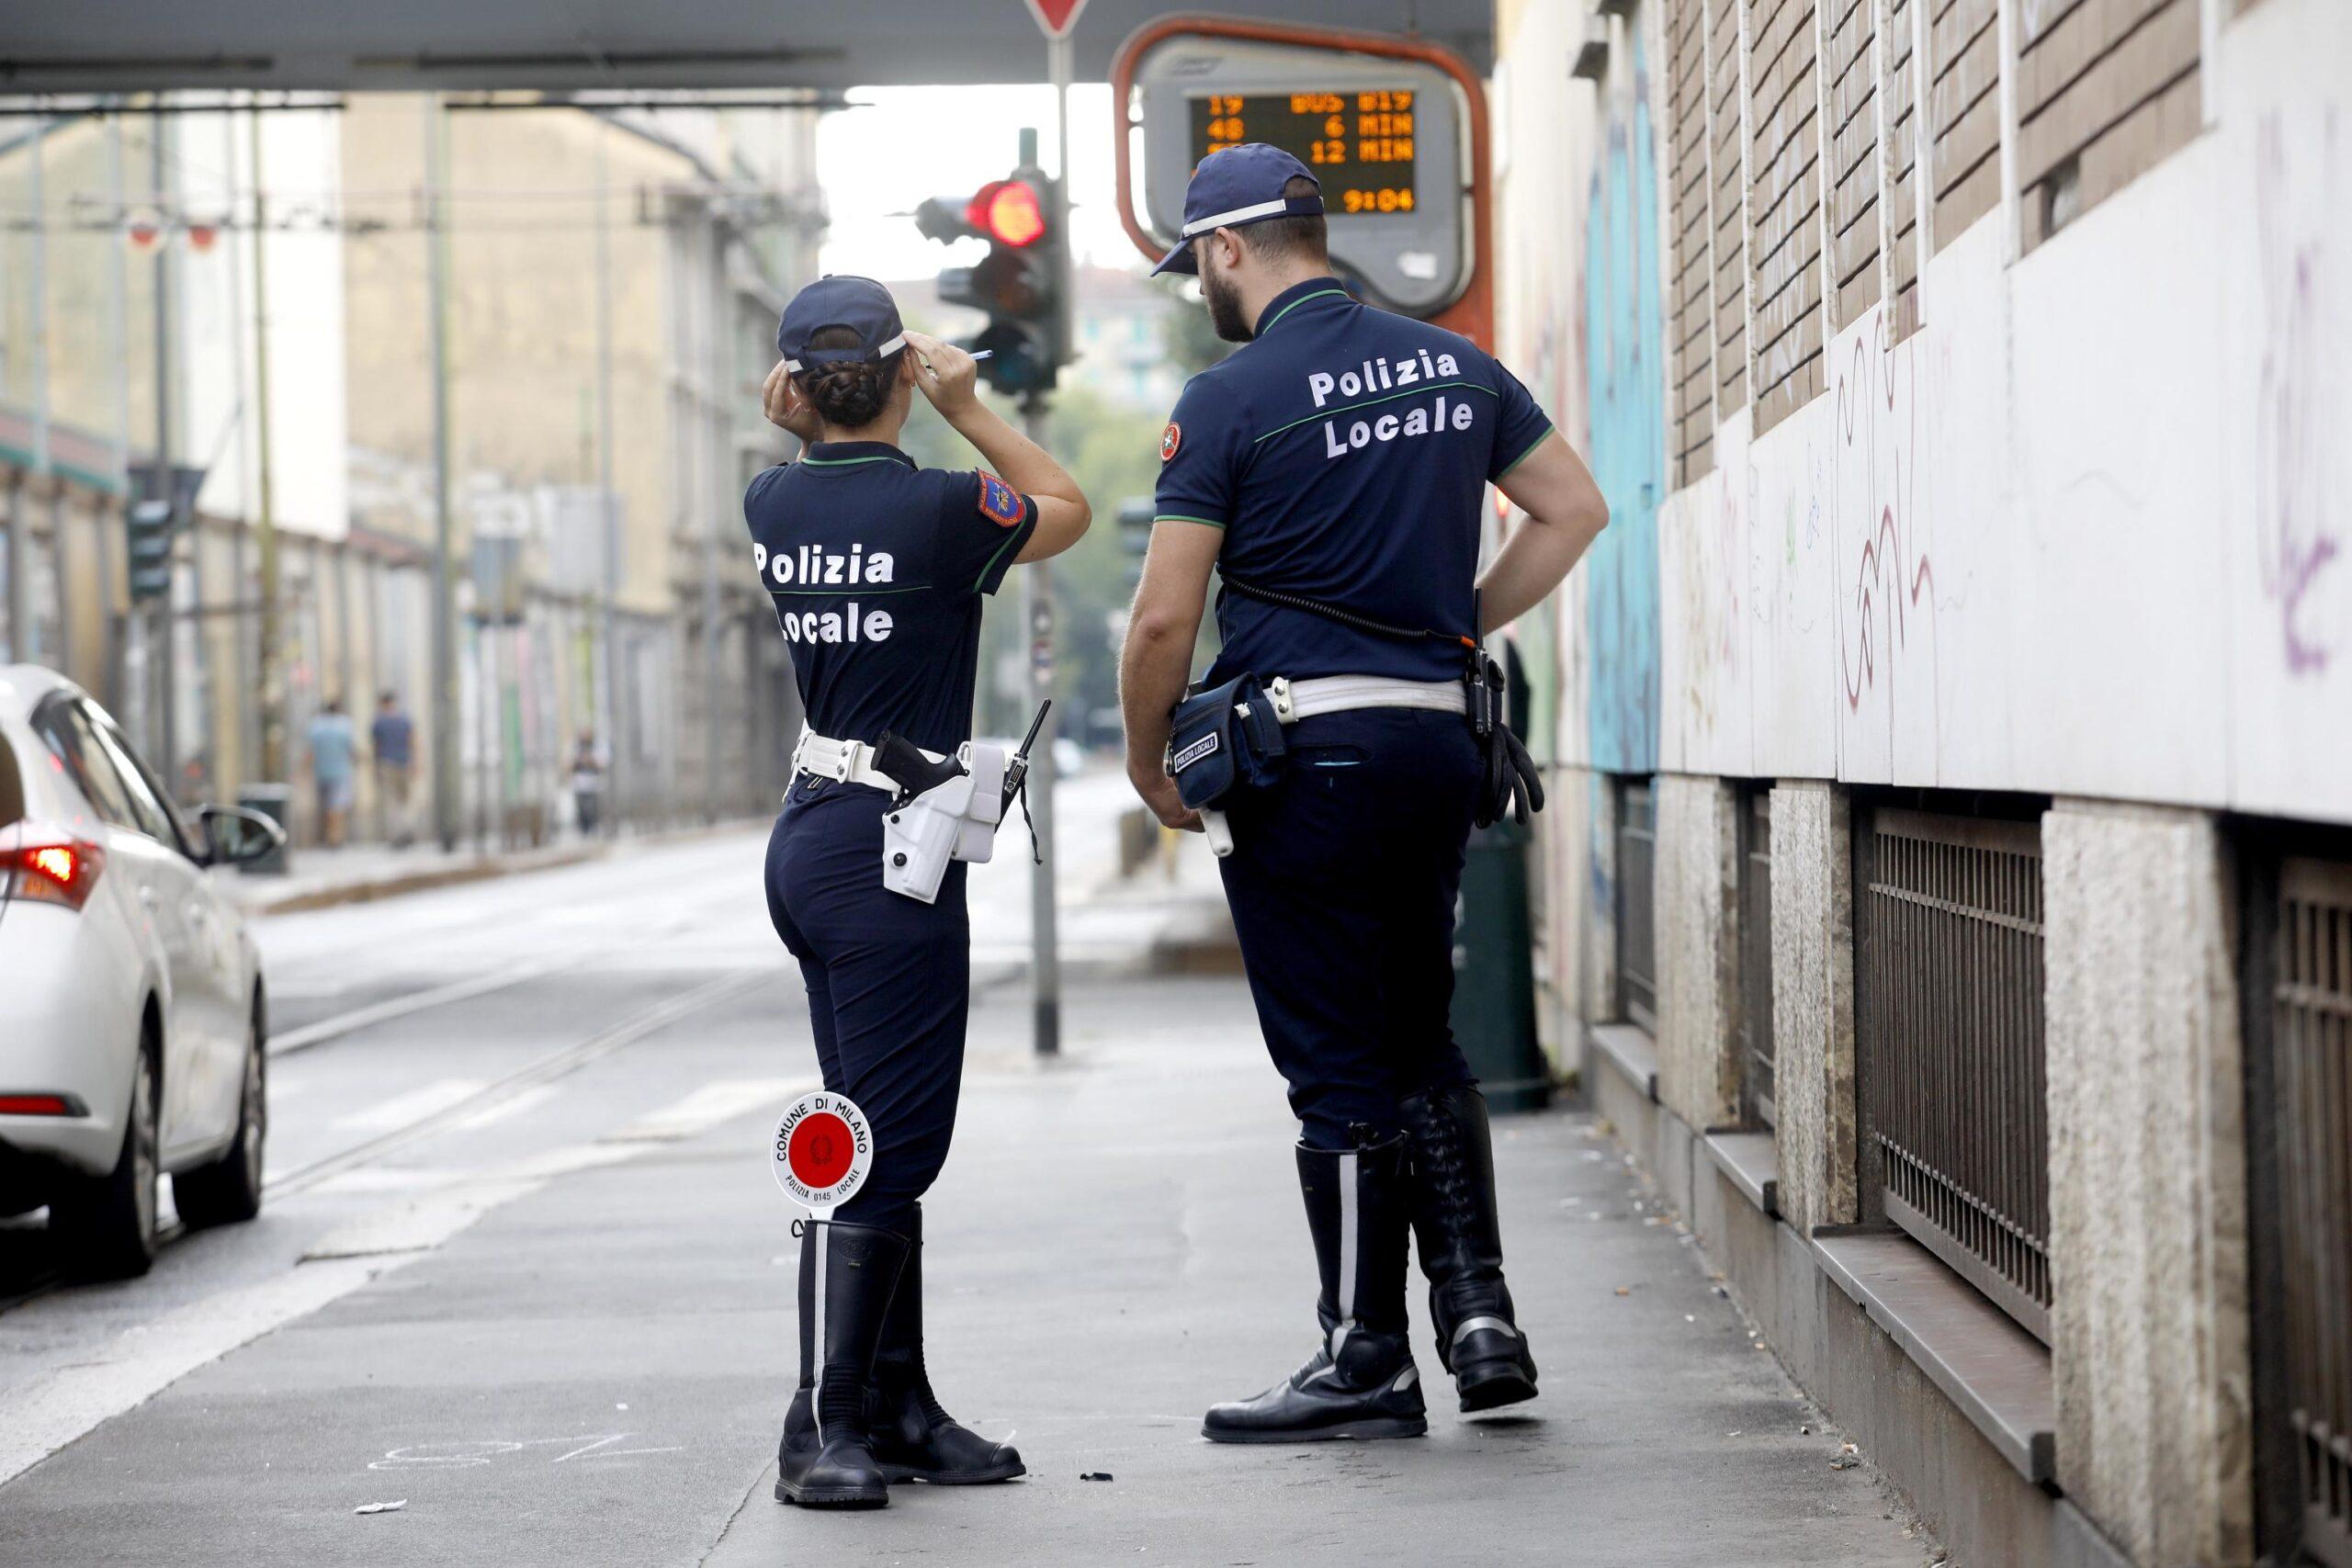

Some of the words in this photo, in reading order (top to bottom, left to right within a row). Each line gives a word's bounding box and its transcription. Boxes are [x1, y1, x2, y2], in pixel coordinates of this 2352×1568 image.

[1290, 93, 1345, 114] BUS
[1206, 118, 1245, 141] 48
[1325, 115, 1345, 138] 6
[1359, 113, 1413, 137] MIN
[1310, 140, 1346, 164] 12
[1359, 138, 1414, 162] MIN
[1342, 188, 1415, 214] 9:04
[1308, 348, 1461, 408] Polizia
[1324, 396, 1474, 459] Locale
[783, 602, 894, 645] ocale
[1177, 749, 1194, 767] POLIZIA
[1194, 738, 1215, 755] LOCALE
[776, 1102, 808, 1161] COMUNE
[815, 1098, 829, 1110] DI
[835, 1101, 867, 1154] MILANO
[786, 1175, 809, 1199] POLIZIA
[813, 1192, 831, 1201] 0145
[837, 1168, 860, 1195] LOCALE
